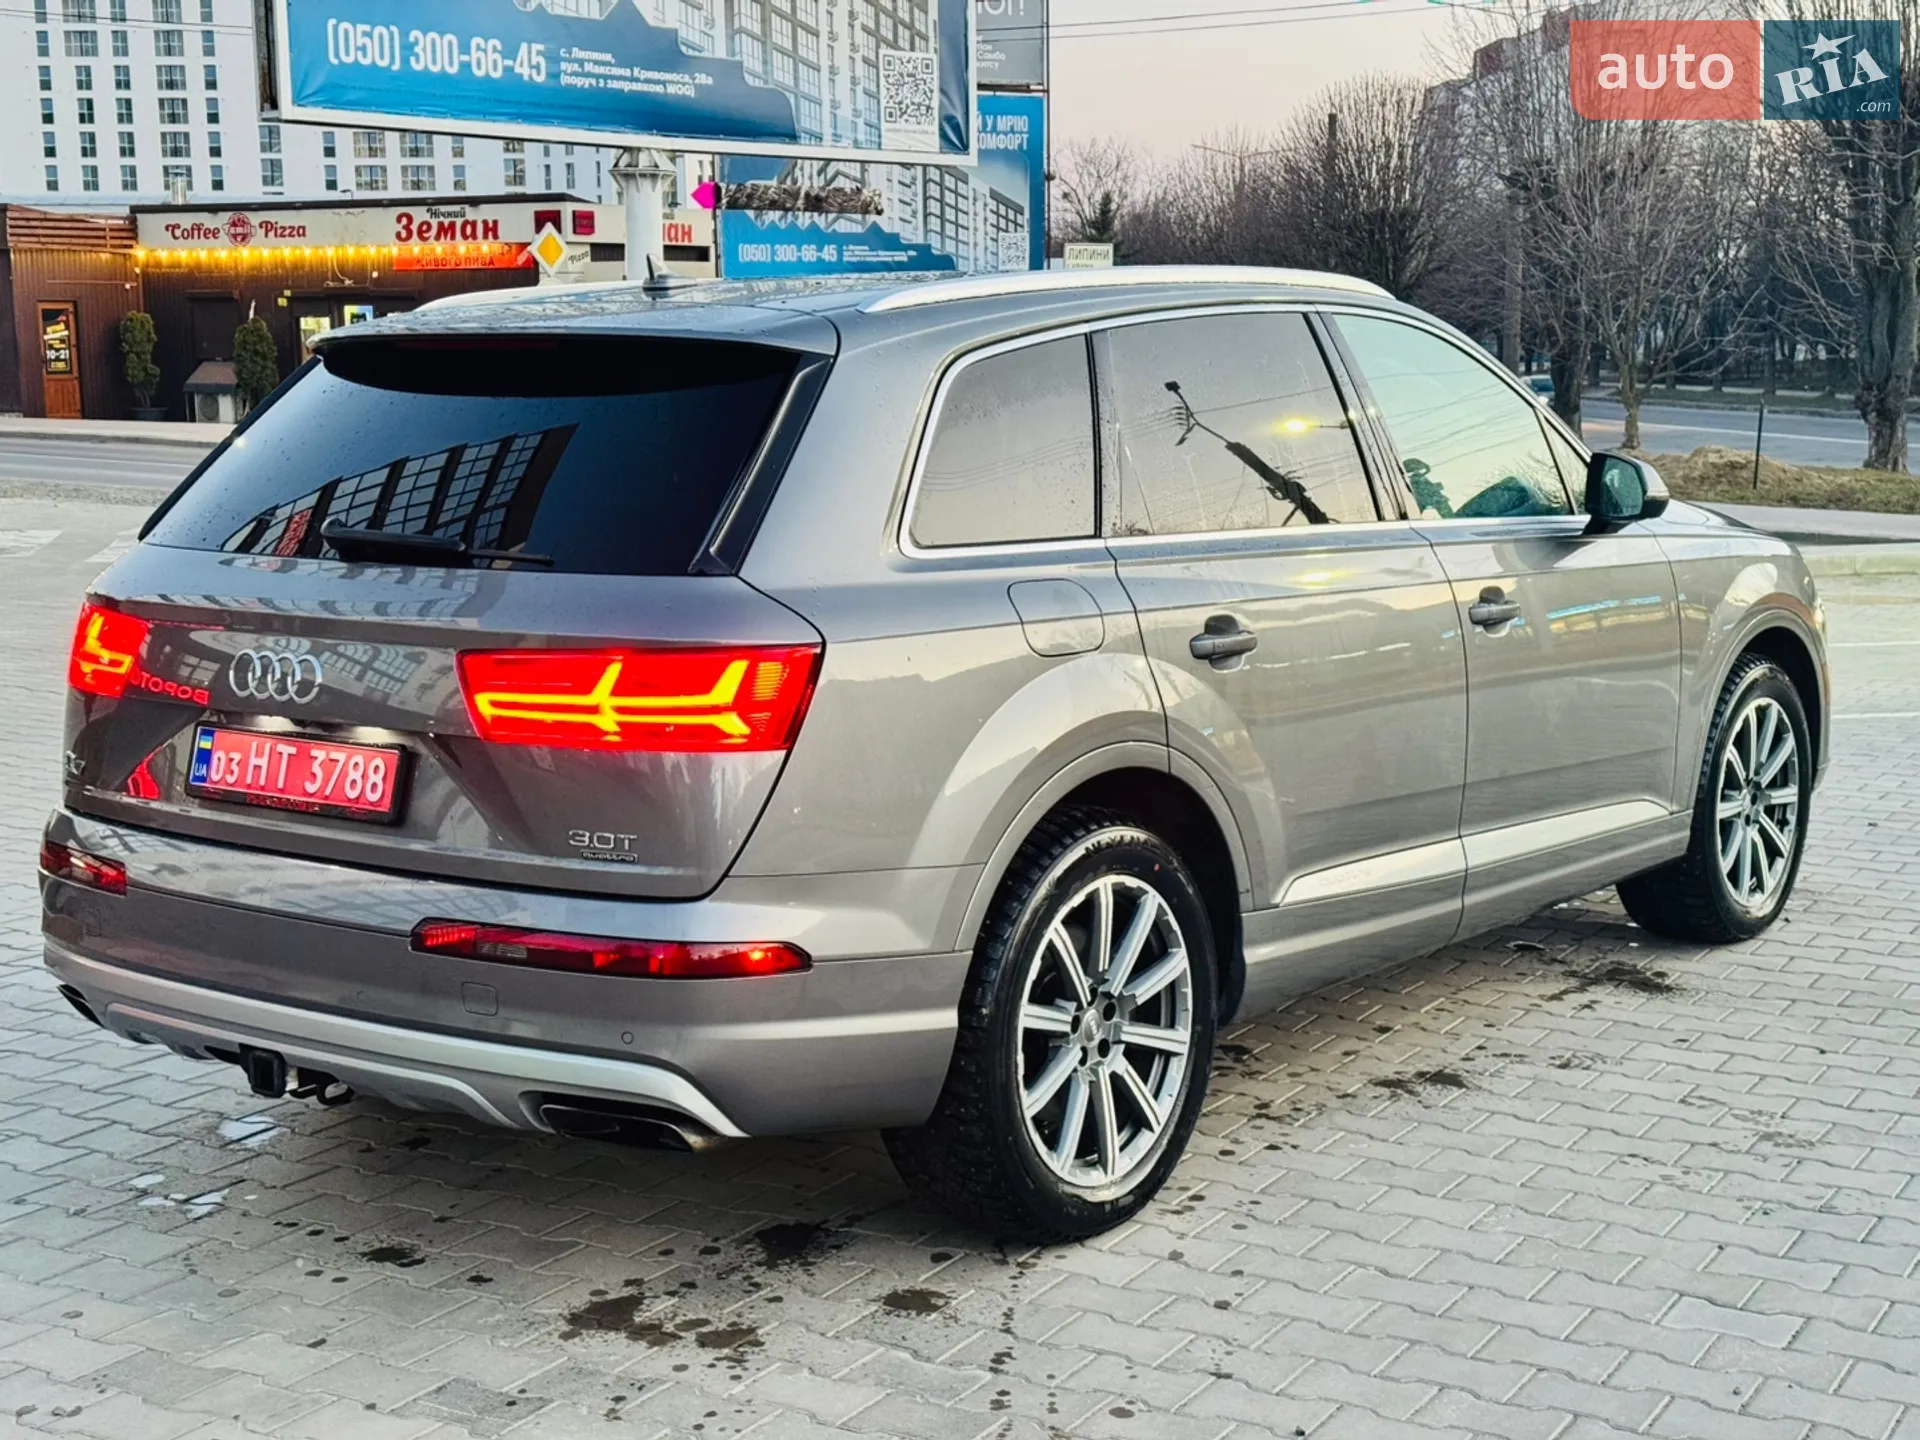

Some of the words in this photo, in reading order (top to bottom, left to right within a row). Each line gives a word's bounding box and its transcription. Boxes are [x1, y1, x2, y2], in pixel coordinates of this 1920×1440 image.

[327, 17, 400, 71] (050)
[409, 29, 547, 83] 300-66-45
[571, 47, 616, 64] Липини,
[560, 61, 582, 74] вул.
[584, 61, 632, 77] Максима
[560, 74, 597, 88] (поруч
[666, 83, 695, 98] WOG)
[165, 222, 220, 240] Coffee
[259, 220, 307, 238] Pizza
[395, 212, 500, 242] Земан
[662, 222, 692, 244] ан
[1068, 248, 1110, 261] ЛИПИНИ
[194, 762, 207, 777] UA
[210, 750, 243, 785] 03
[304, 748, 386, 803] 3788
[581, 851, 635, 862] quattro
